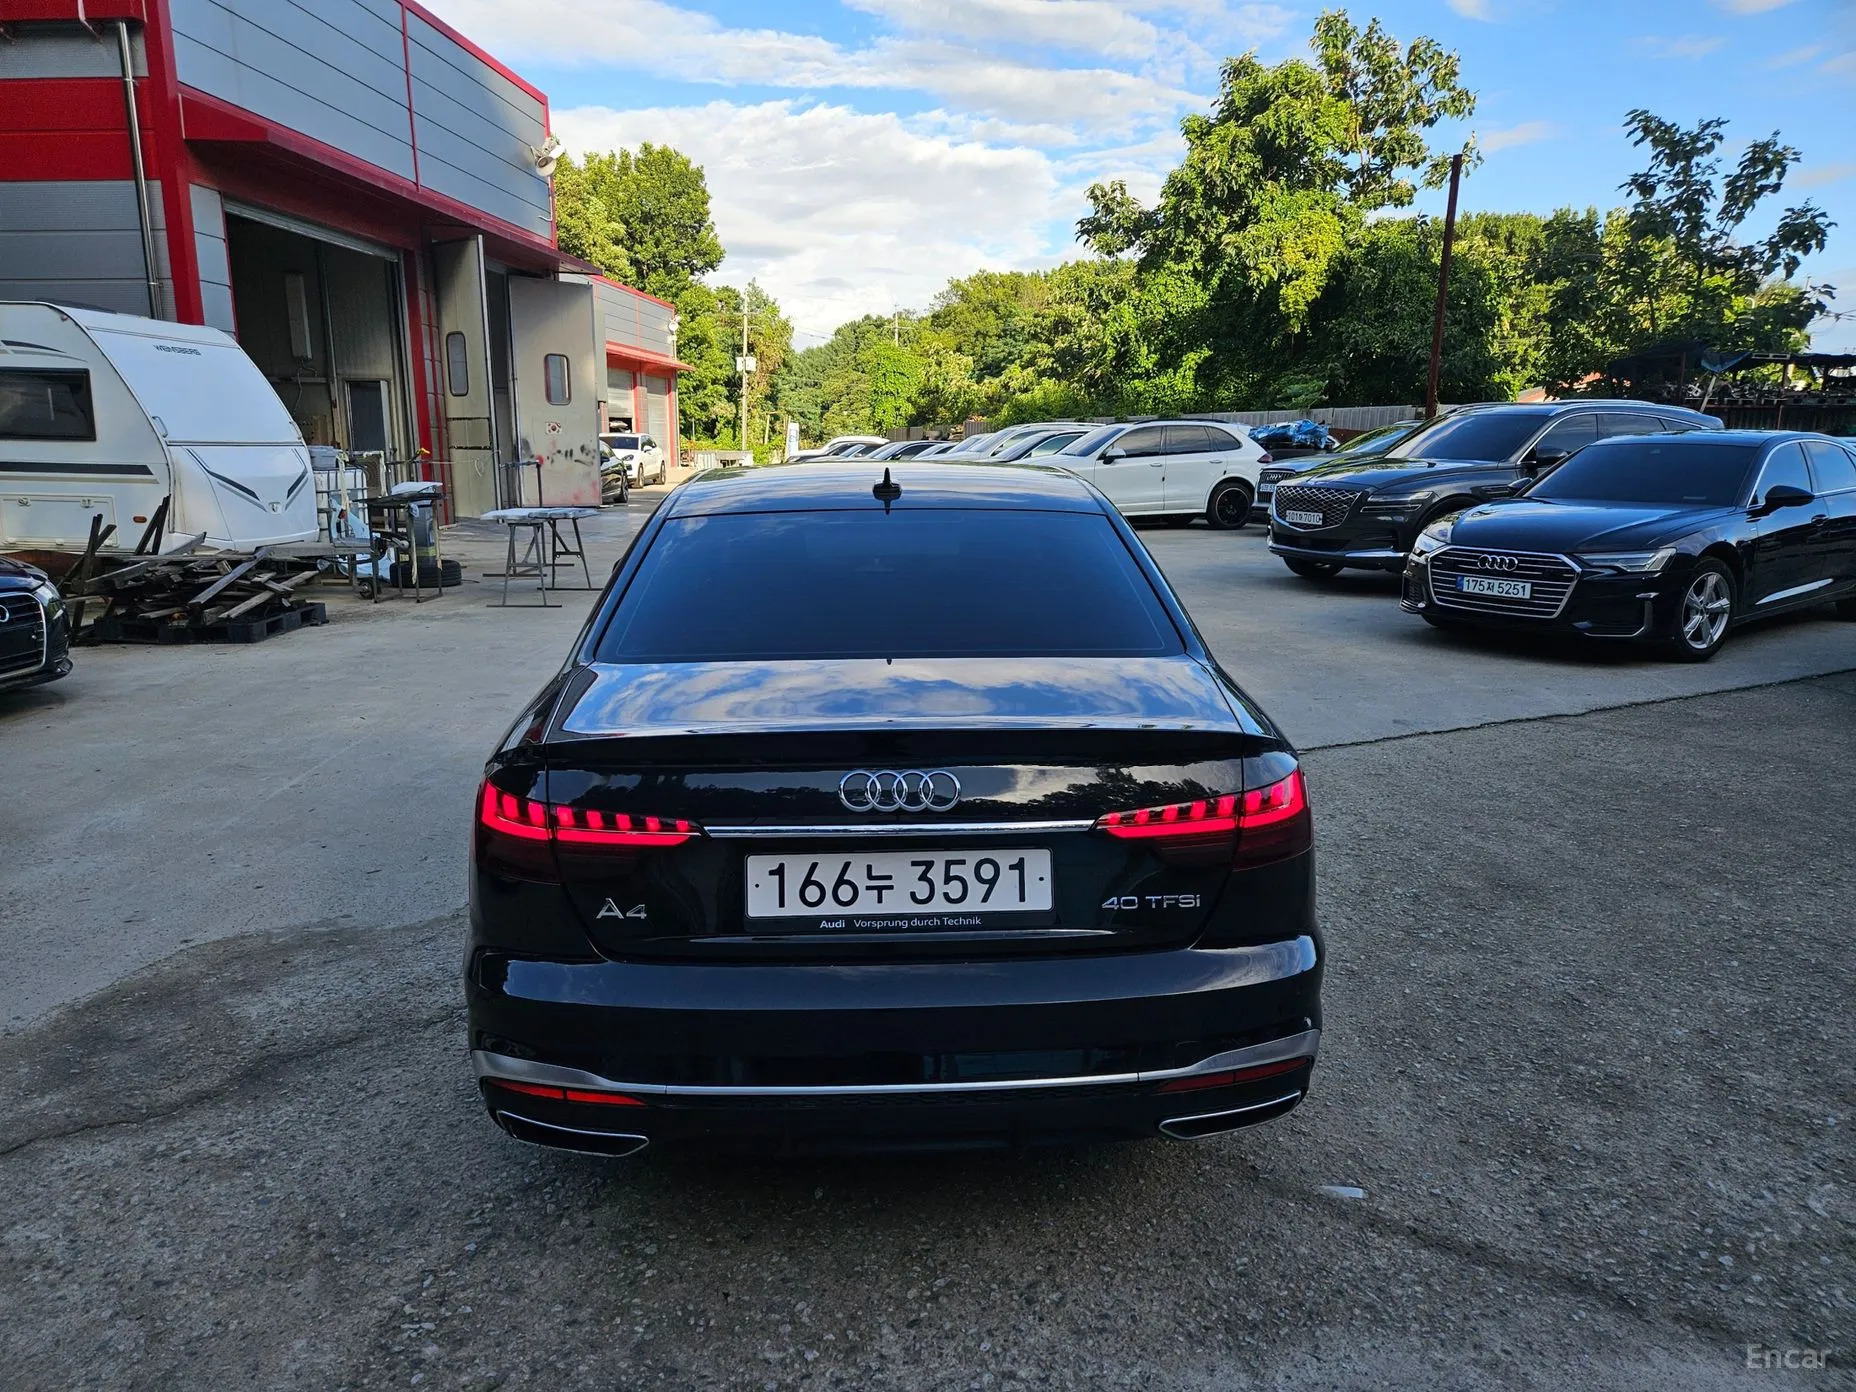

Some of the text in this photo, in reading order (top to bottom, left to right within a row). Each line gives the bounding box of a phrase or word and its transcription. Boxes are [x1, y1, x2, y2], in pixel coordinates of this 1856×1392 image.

[1497, 582, 1526, 597] 5251
[768, 857, 1025, 909] 166누 3591
[596, 897, 647, 920] A4
[1101, 896, 1139, 910] 40
[819, 916, 982, 930] Audi Vorsprung durch Technik
